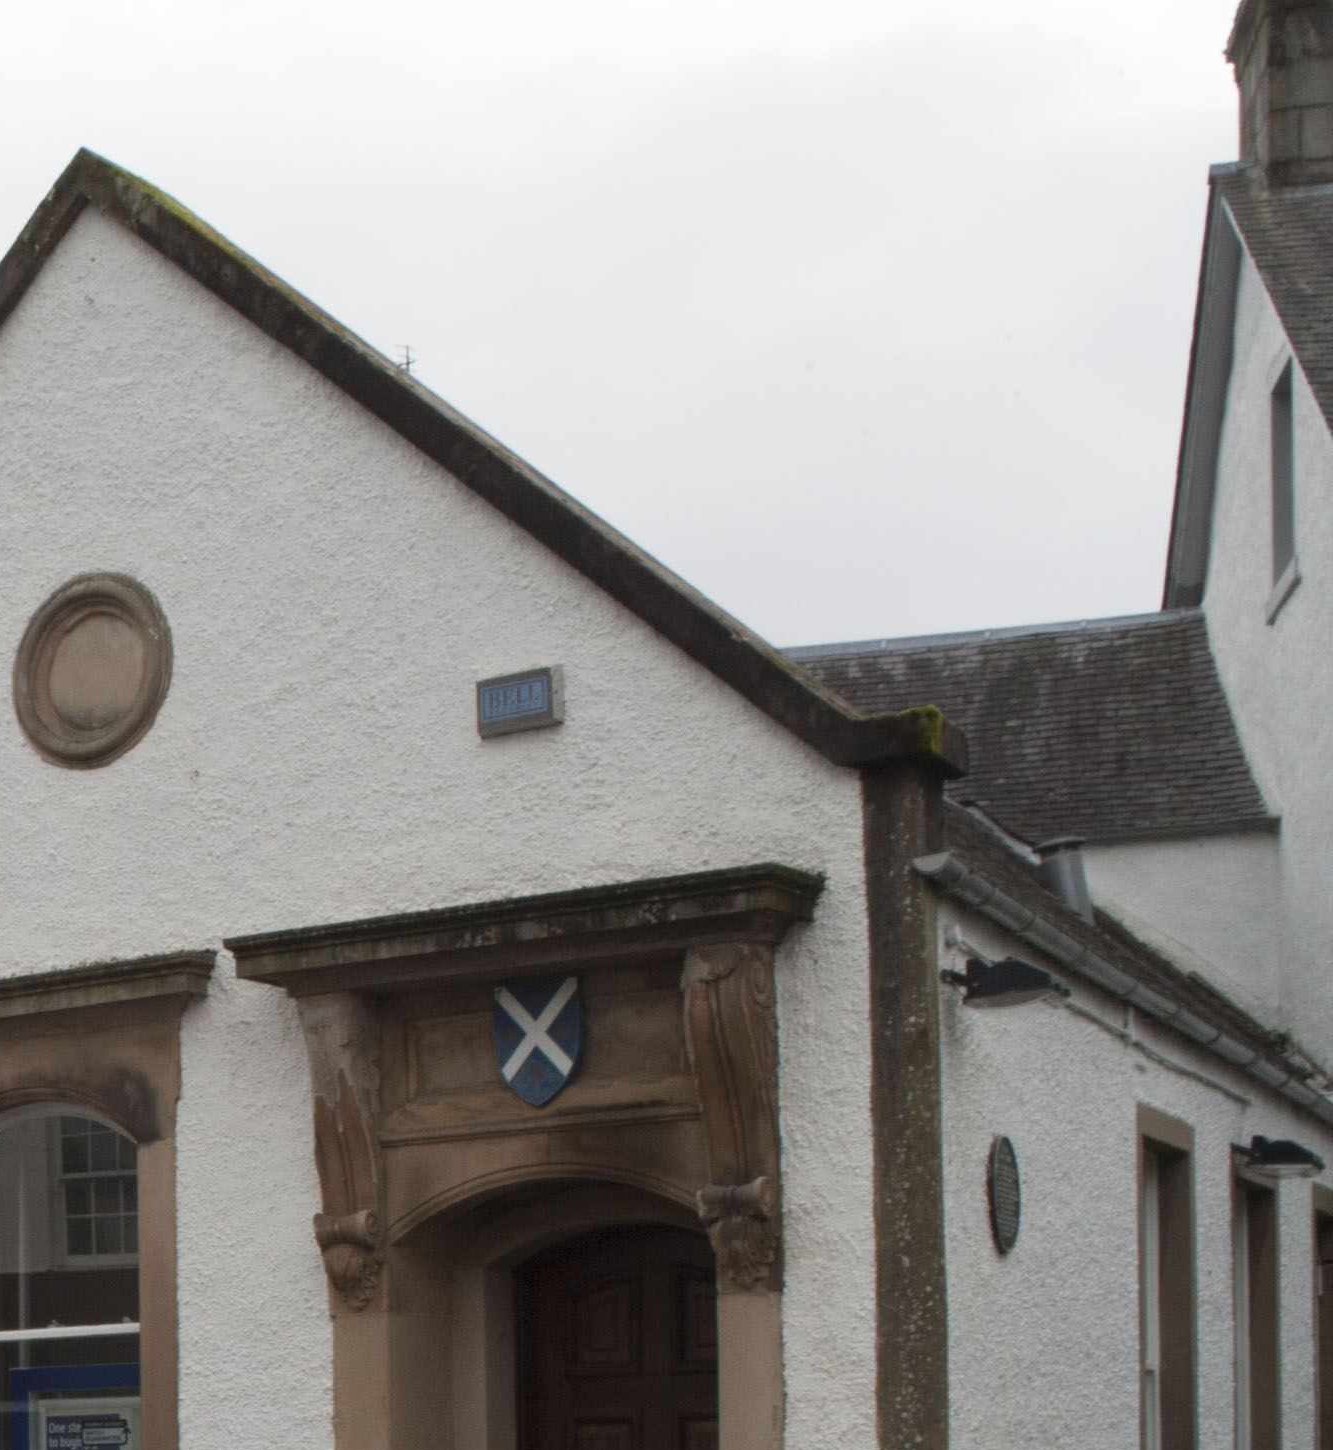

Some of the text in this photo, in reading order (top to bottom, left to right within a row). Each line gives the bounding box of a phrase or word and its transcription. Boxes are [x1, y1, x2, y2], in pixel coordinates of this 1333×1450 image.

[49, 1422, 66, 1433] One
[68, 1421, 81, 1433] ste
[49, 1437, 58, 1447] to
